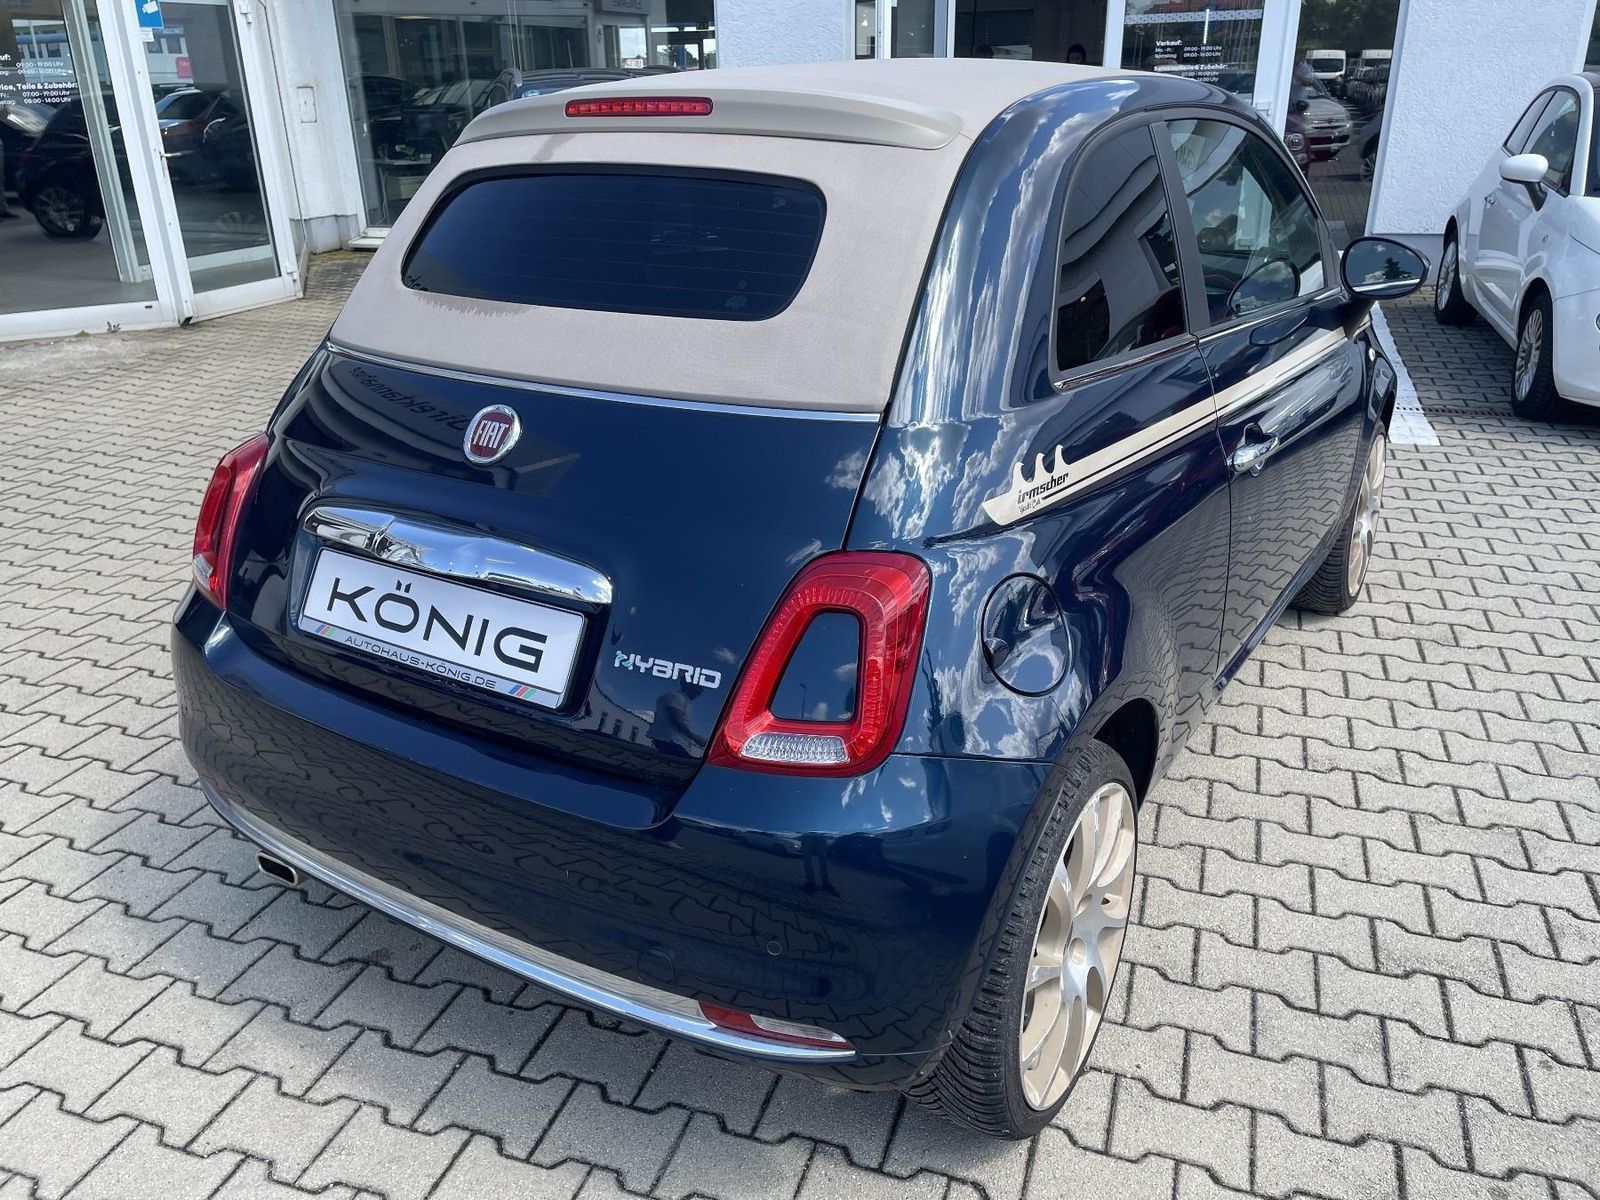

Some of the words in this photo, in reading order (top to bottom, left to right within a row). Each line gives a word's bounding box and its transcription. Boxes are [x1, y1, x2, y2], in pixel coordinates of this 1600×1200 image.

[473, 420, 509, 449] FIAT
[1018, 473, 1069, 504] irmscher
[327, 578, 548, 673] KÖNIG
[344, 635, 497, 690] AUTOHAUS-KÖNIG.DE
[614, 651, 722, 689] HYBRID
